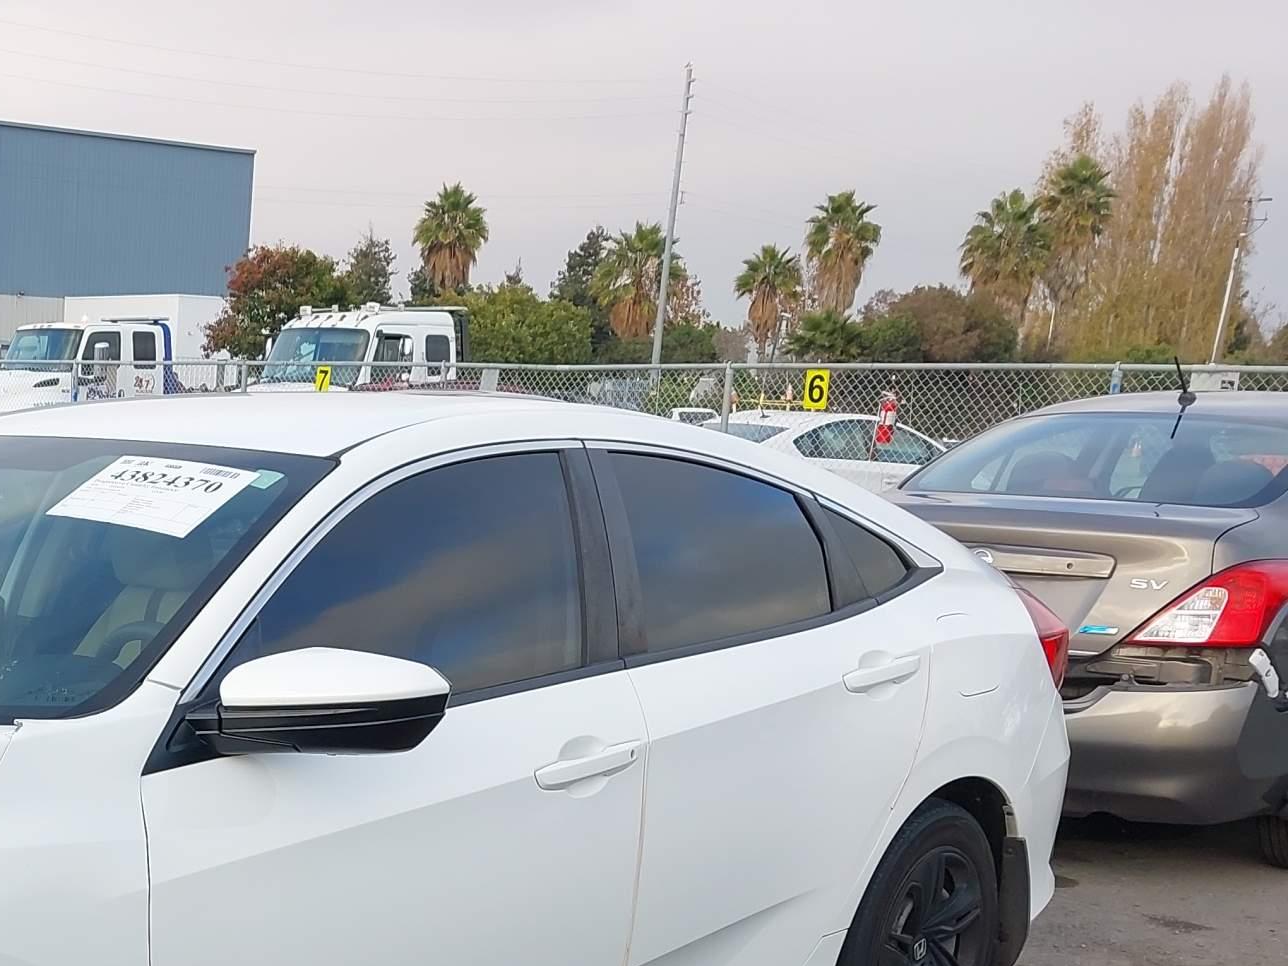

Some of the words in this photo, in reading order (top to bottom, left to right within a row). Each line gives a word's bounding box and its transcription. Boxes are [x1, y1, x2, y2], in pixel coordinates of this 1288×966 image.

[319, 369, 329, 392] 7
[808, 374, 825, 404] 6
[110, 469, 223, 494] 43824370
[1130, 578, 1169, 590] SV
